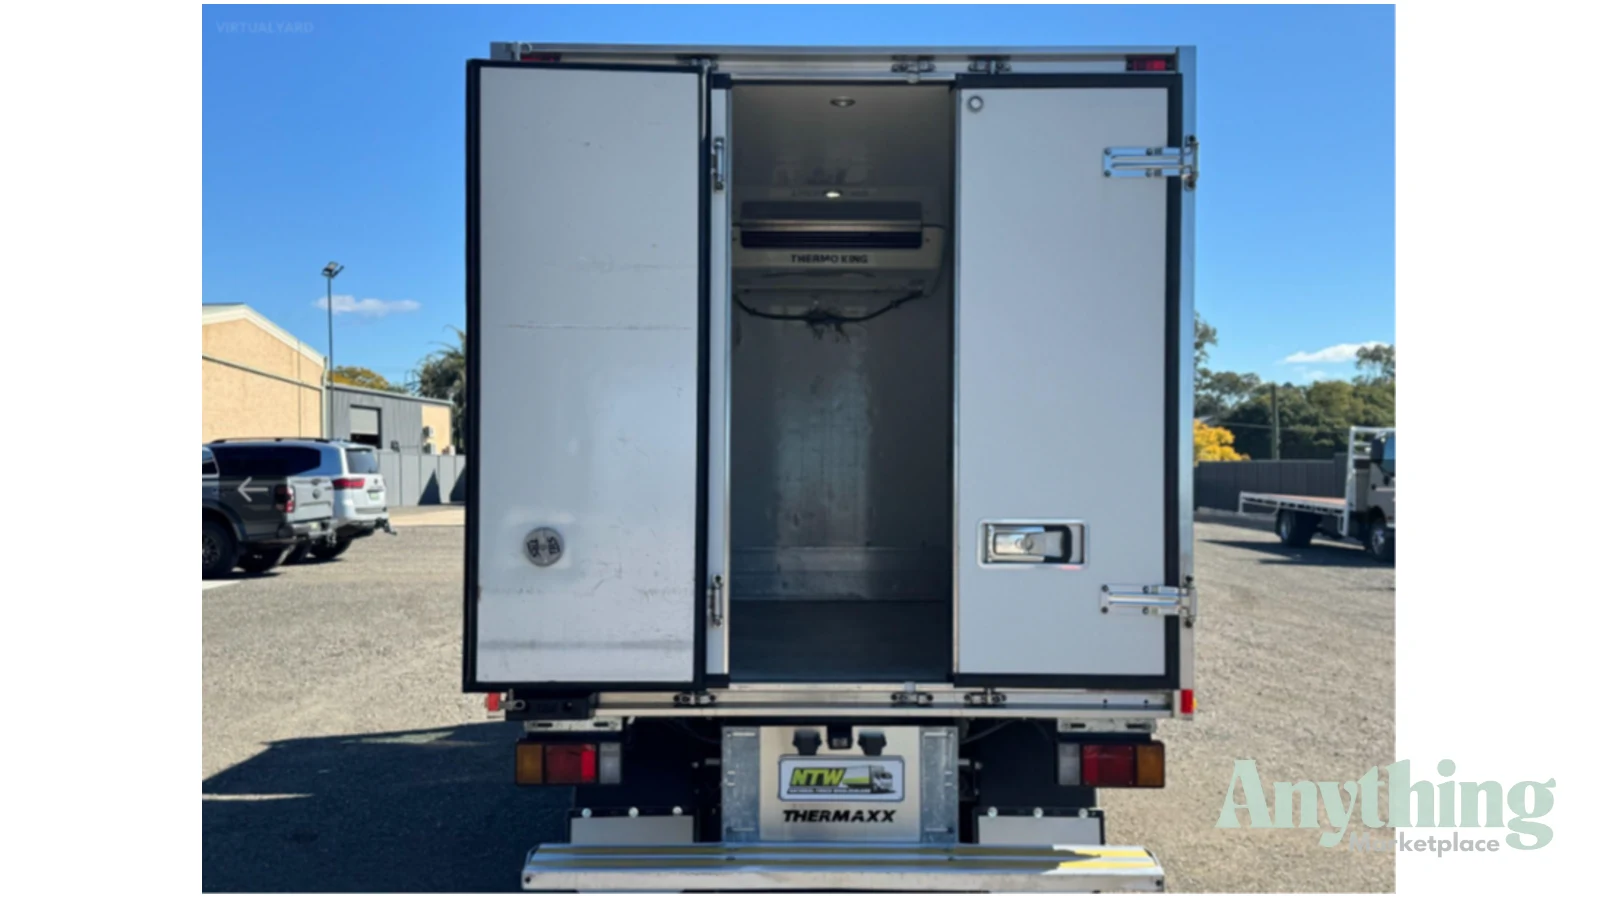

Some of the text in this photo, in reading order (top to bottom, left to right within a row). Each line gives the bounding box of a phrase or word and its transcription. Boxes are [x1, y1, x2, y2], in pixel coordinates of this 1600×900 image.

[791, 254, 868, 264] THERMO KING
[792, 768, 844, 785] NTW
[783, 809, 896, 823] THERMAXX
